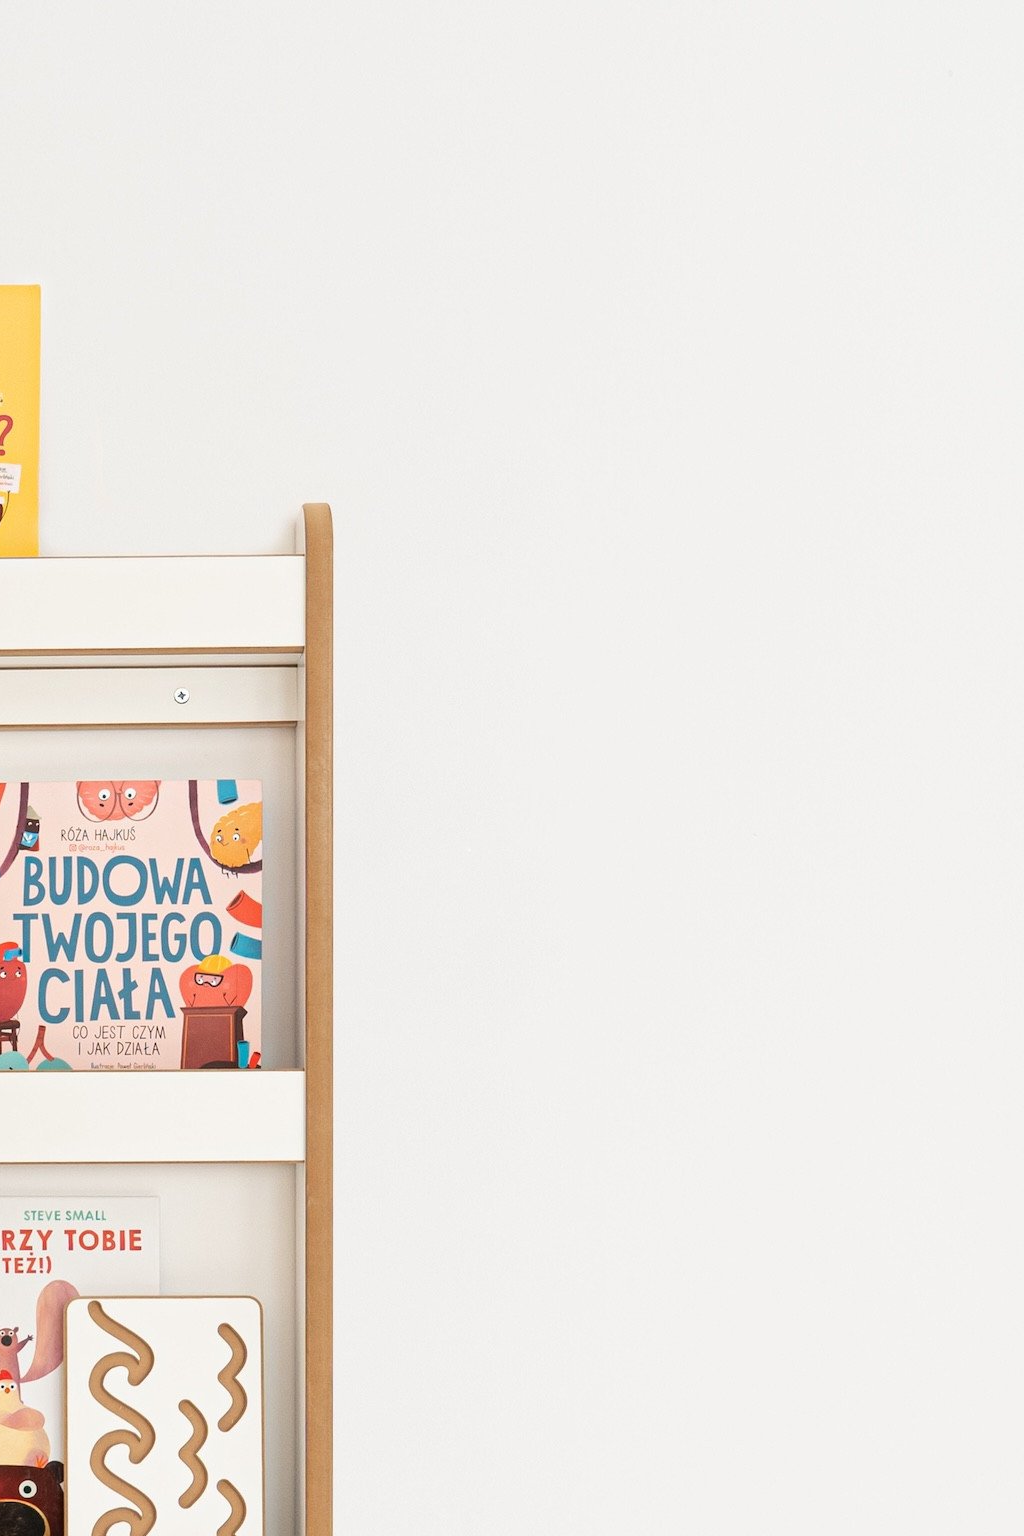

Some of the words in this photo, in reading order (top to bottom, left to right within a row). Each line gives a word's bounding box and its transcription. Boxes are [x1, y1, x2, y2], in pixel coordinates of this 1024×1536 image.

[61, 826, 89, 841] RÓŻA
[94, 826, 136, 841] HAJKUŚ
[23, 855, 213, 907] BUDOWA
[12, 911, 223, 963] TWOJEGO
[38, 967, 176, 1024] CIAŁA
[72, 1025, 88, 1040] CO
[94, 1025, 126, 1040] JEST
[132, 1025, 166, 1040] CZYM
[78, 1042, 81, 1056] I
[87, 1042, 111, 1056] JAK
[117, 1042, 160, 1056] DZIAŁA
[24, 1210, 61, 1221] STEVE
[65, 1210, 107, 1221] SMALL
[64, 1229, 142, 1251] TOBIE
[2, 1252, 52, 1274] TEŻ!)
